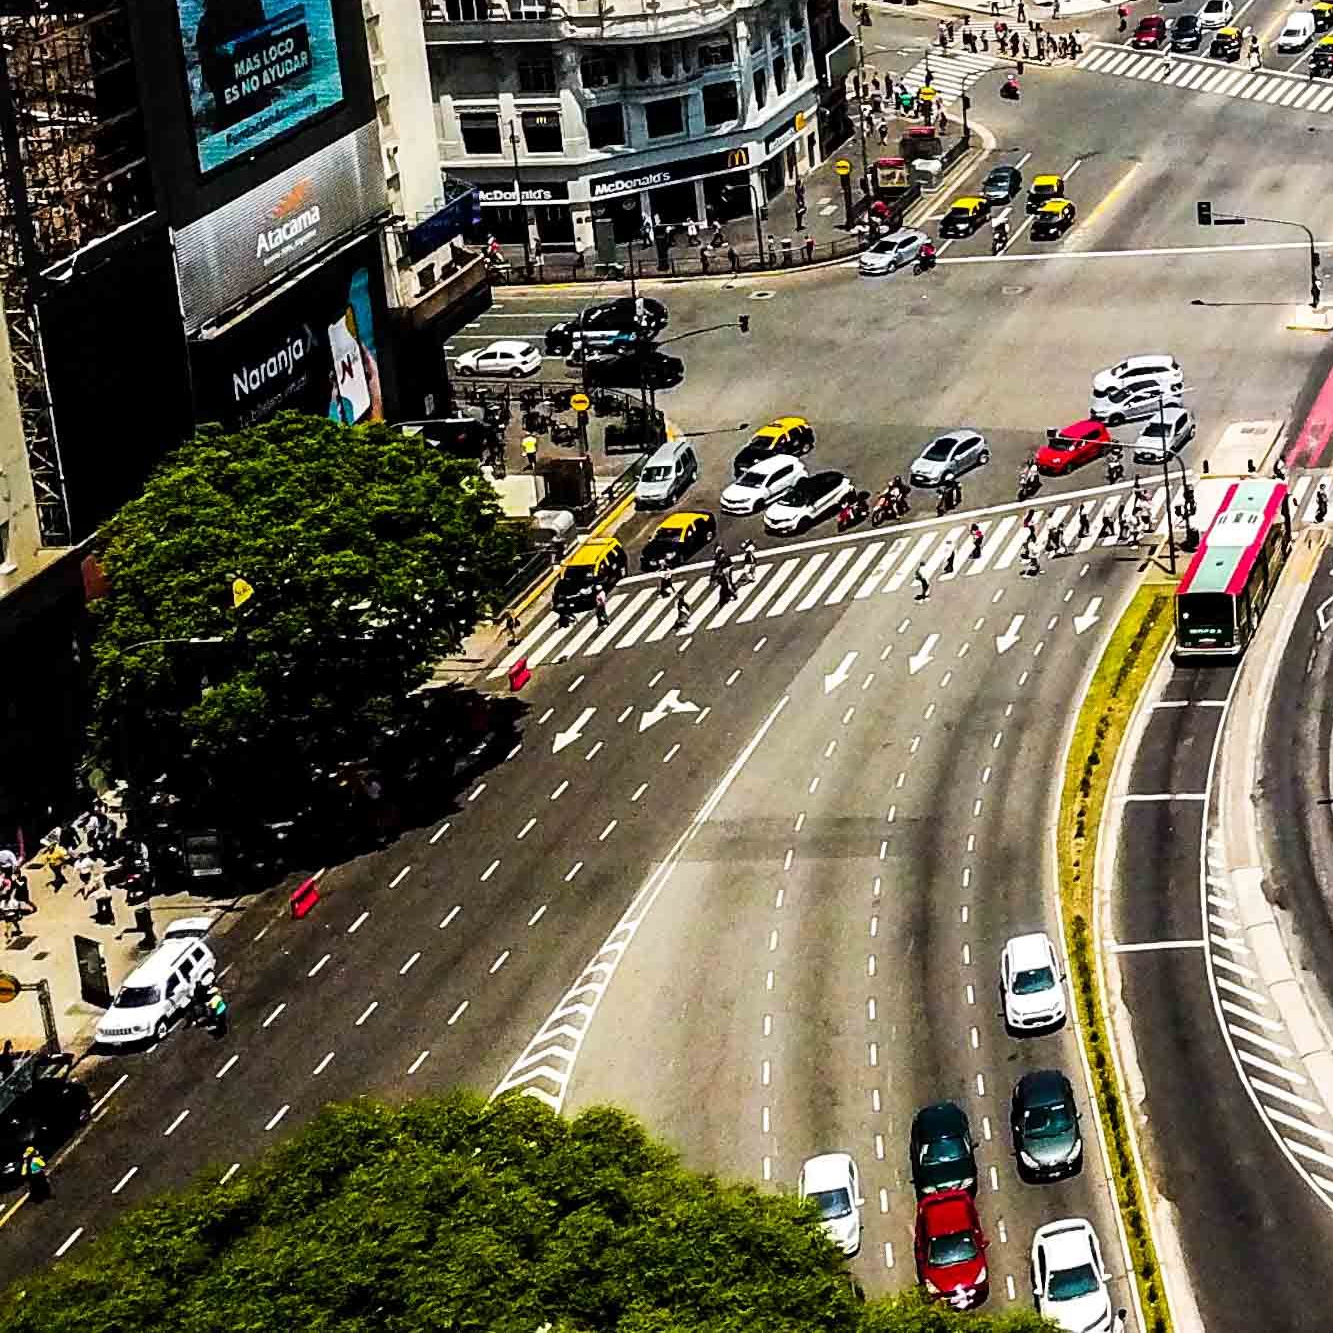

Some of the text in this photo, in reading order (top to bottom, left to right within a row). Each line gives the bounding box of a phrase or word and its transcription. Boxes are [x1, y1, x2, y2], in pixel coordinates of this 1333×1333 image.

[224, 50, 309, 105] ES NO AYUDAR
[263, 37, 294, 66] LOCO
[594, 171, 672, 196] McDonald's
[256, 205, 320, 258] Atacama
[232, 337, 304, 401] Naranja
